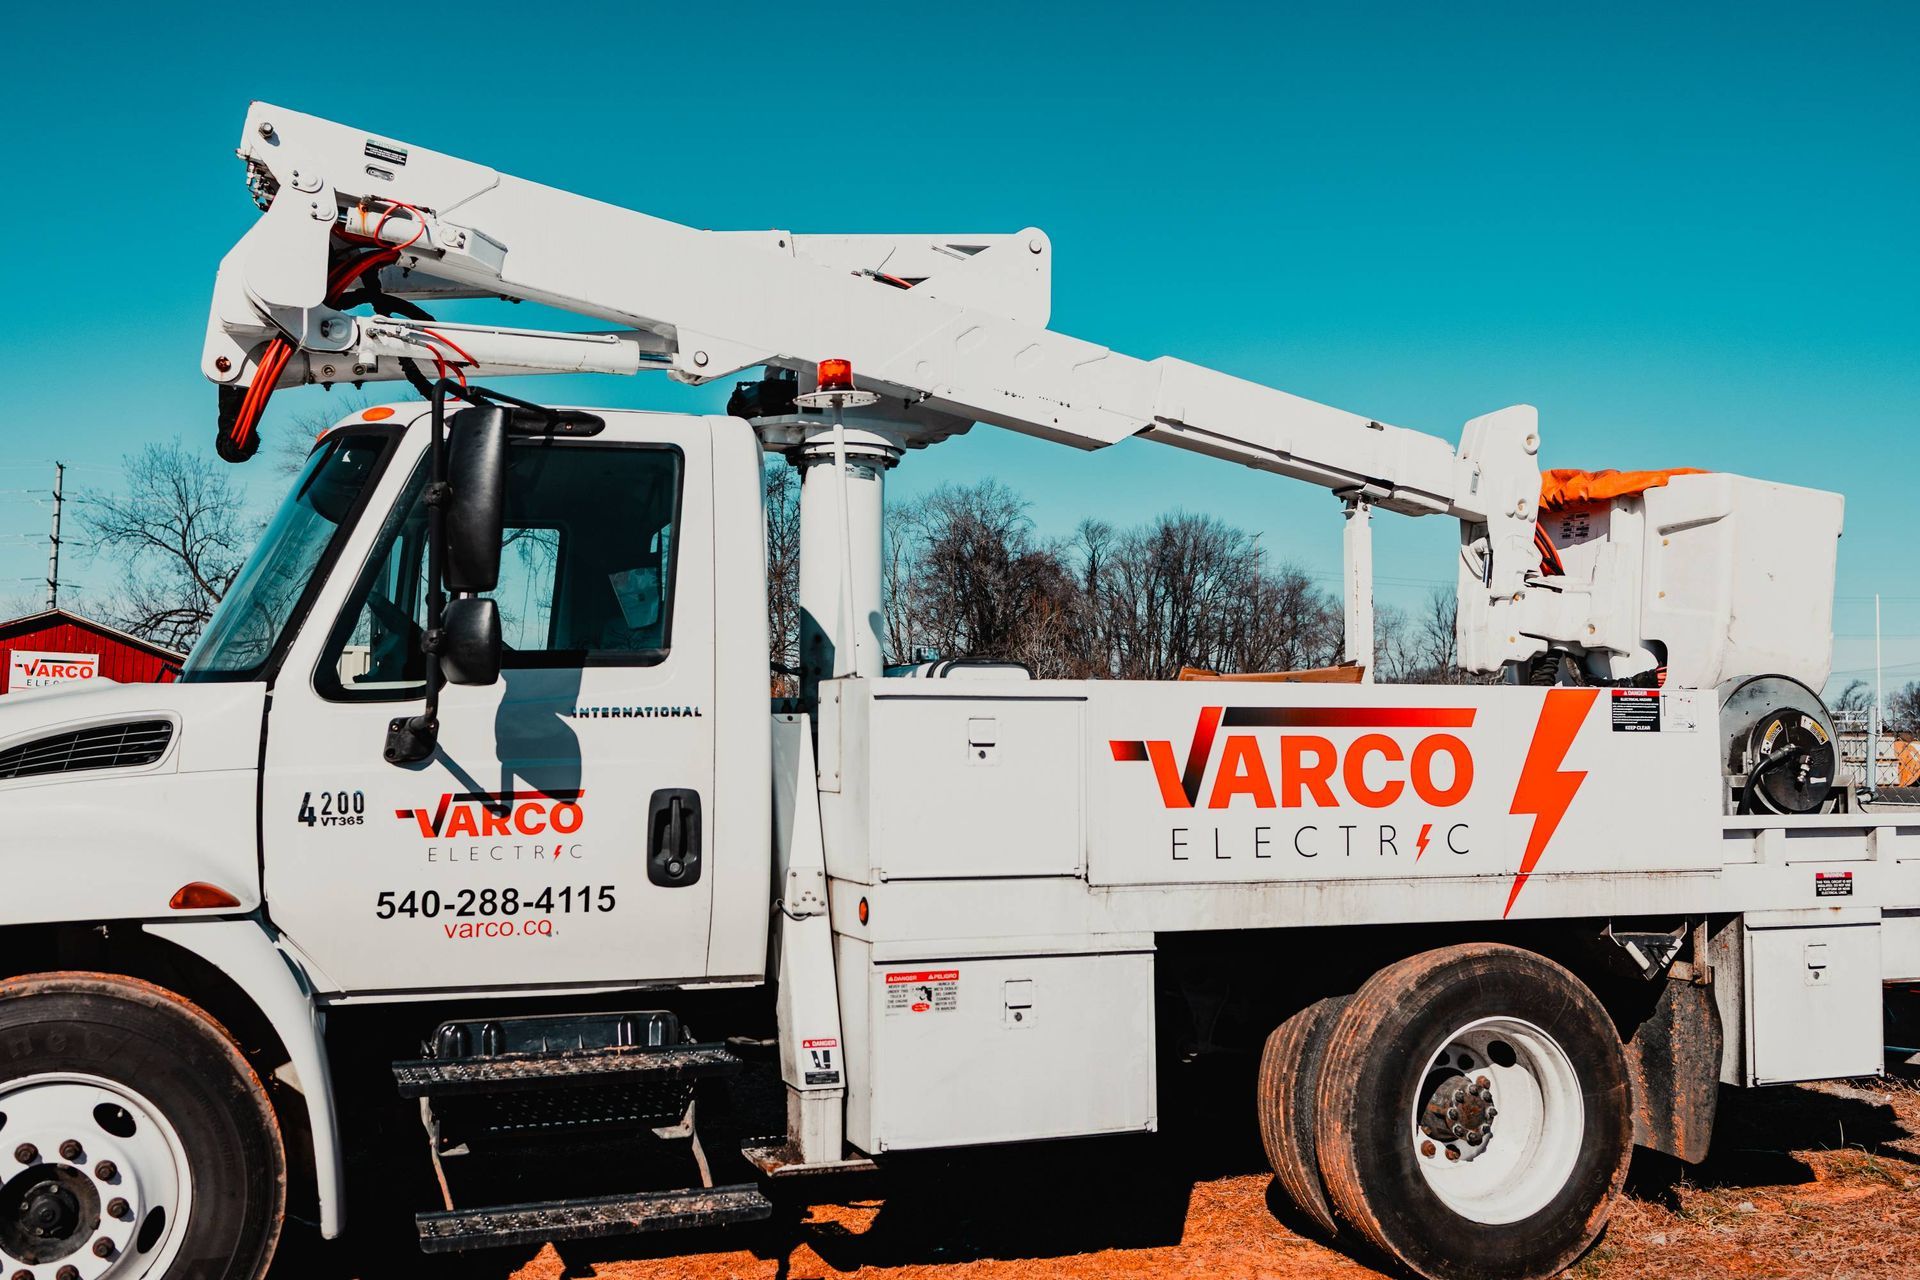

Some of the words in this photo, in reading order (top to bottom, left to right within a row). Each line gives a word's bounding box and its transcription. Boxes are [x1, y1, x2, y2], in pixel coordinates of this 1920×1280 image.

[15, 658, 94, 680] VARCO
[571, 706, 703, 719] INTERNATIONAL
[1109, 706, 1477, 809] VARCO
[298, 789, 365, 828] 4200
[321, 815, 364, 827] VT365
[395, 789, 586, 839] VARCO
[376, 885, 616, 920] 540-288-4115
[933, 972, 957, 980] PELIGRO
